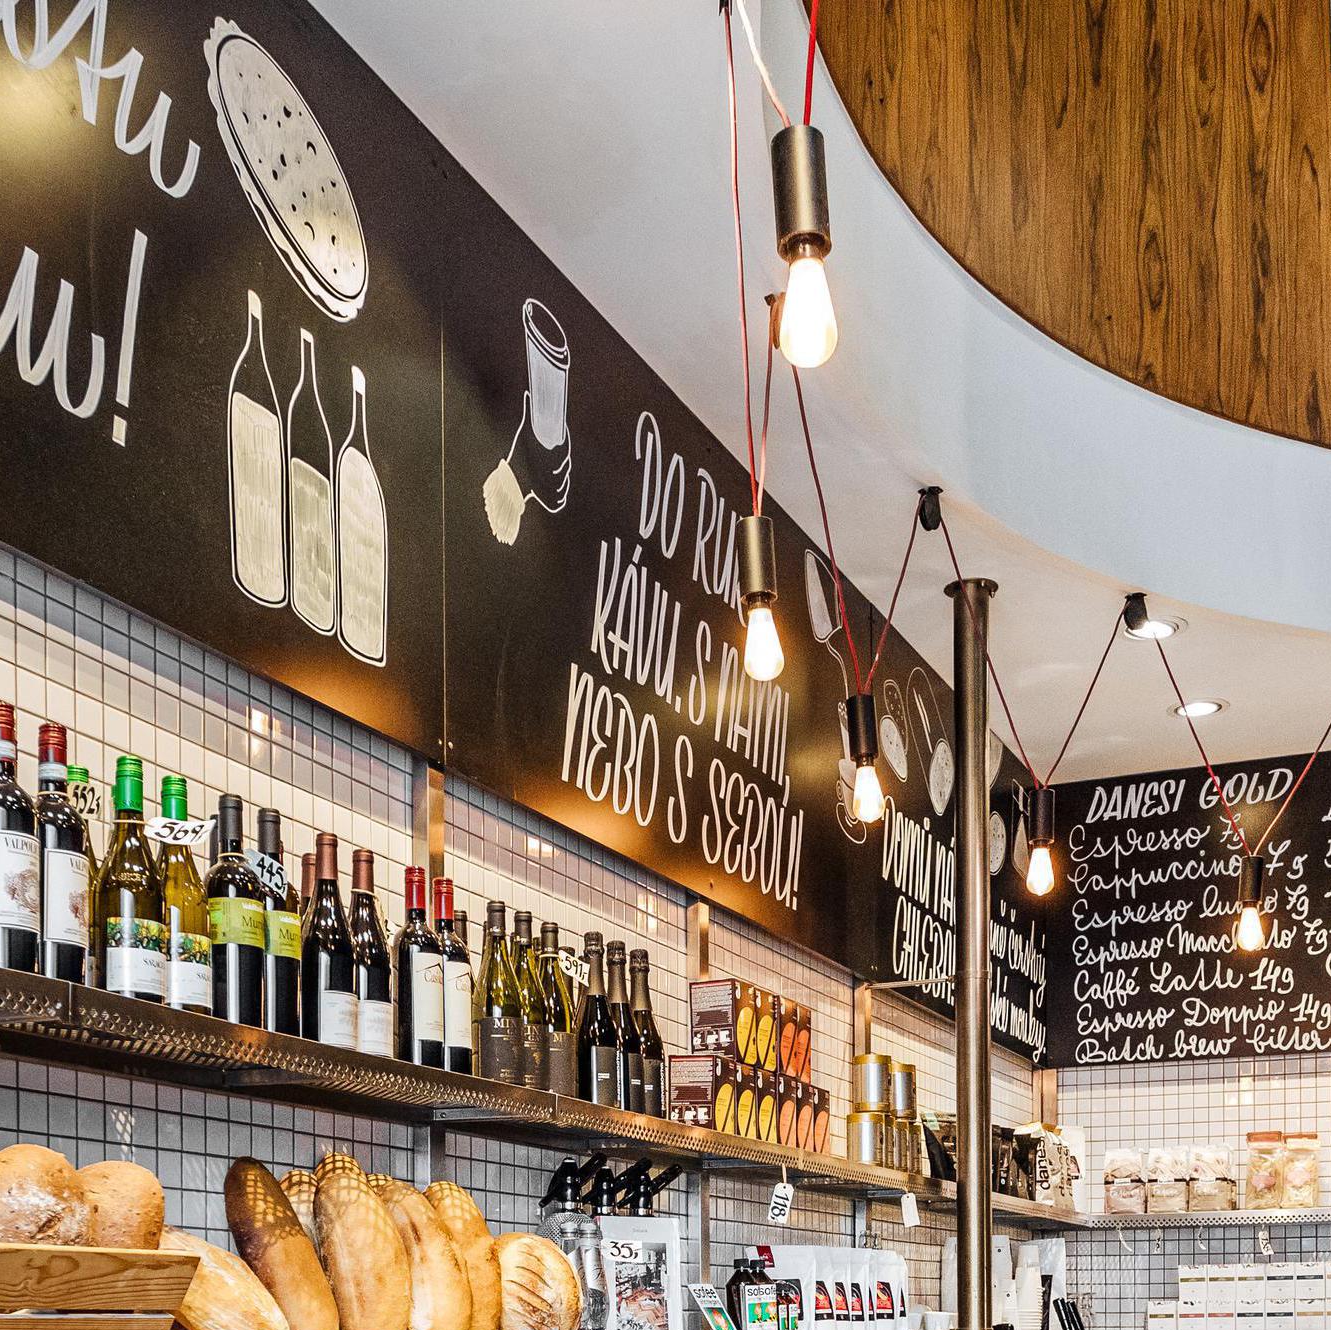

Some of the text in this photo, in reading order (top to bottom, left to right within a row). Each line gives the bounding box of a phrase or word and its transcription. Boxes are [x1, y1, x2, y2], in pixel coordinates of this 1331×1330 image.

[636, 411, 686, 559] DO
[689, 621, 713, 728] S
[669, 735, 694, 845] S
[1086, 768, 1294, 824] DANESI GOLD
[1069, 824, 1211, 868] Espresso
[1067, 850, 1243, 899] Cappuccino
[1072, 899, 1194, 937] Espresso
[1199, 885, 1279, 919] luno
[1072, 935, 1165, 972] Espresso
[1074, 967, 1141, 1009] Caffé
[1149, 957, 1244, 995] Latte
[1248, 957, 1295, 995] 14g
[1075, 1034, 1164, 1064] Batch
[1169, 1029, 1237, 1058] brew
[1246, 1023, 1331, 1053] filter
[1076, 1003, 1176, 1042] Espresso
[1182, 997, 1285, 1035] Doppio
[1289, 993, 1331, 1030] 14g
